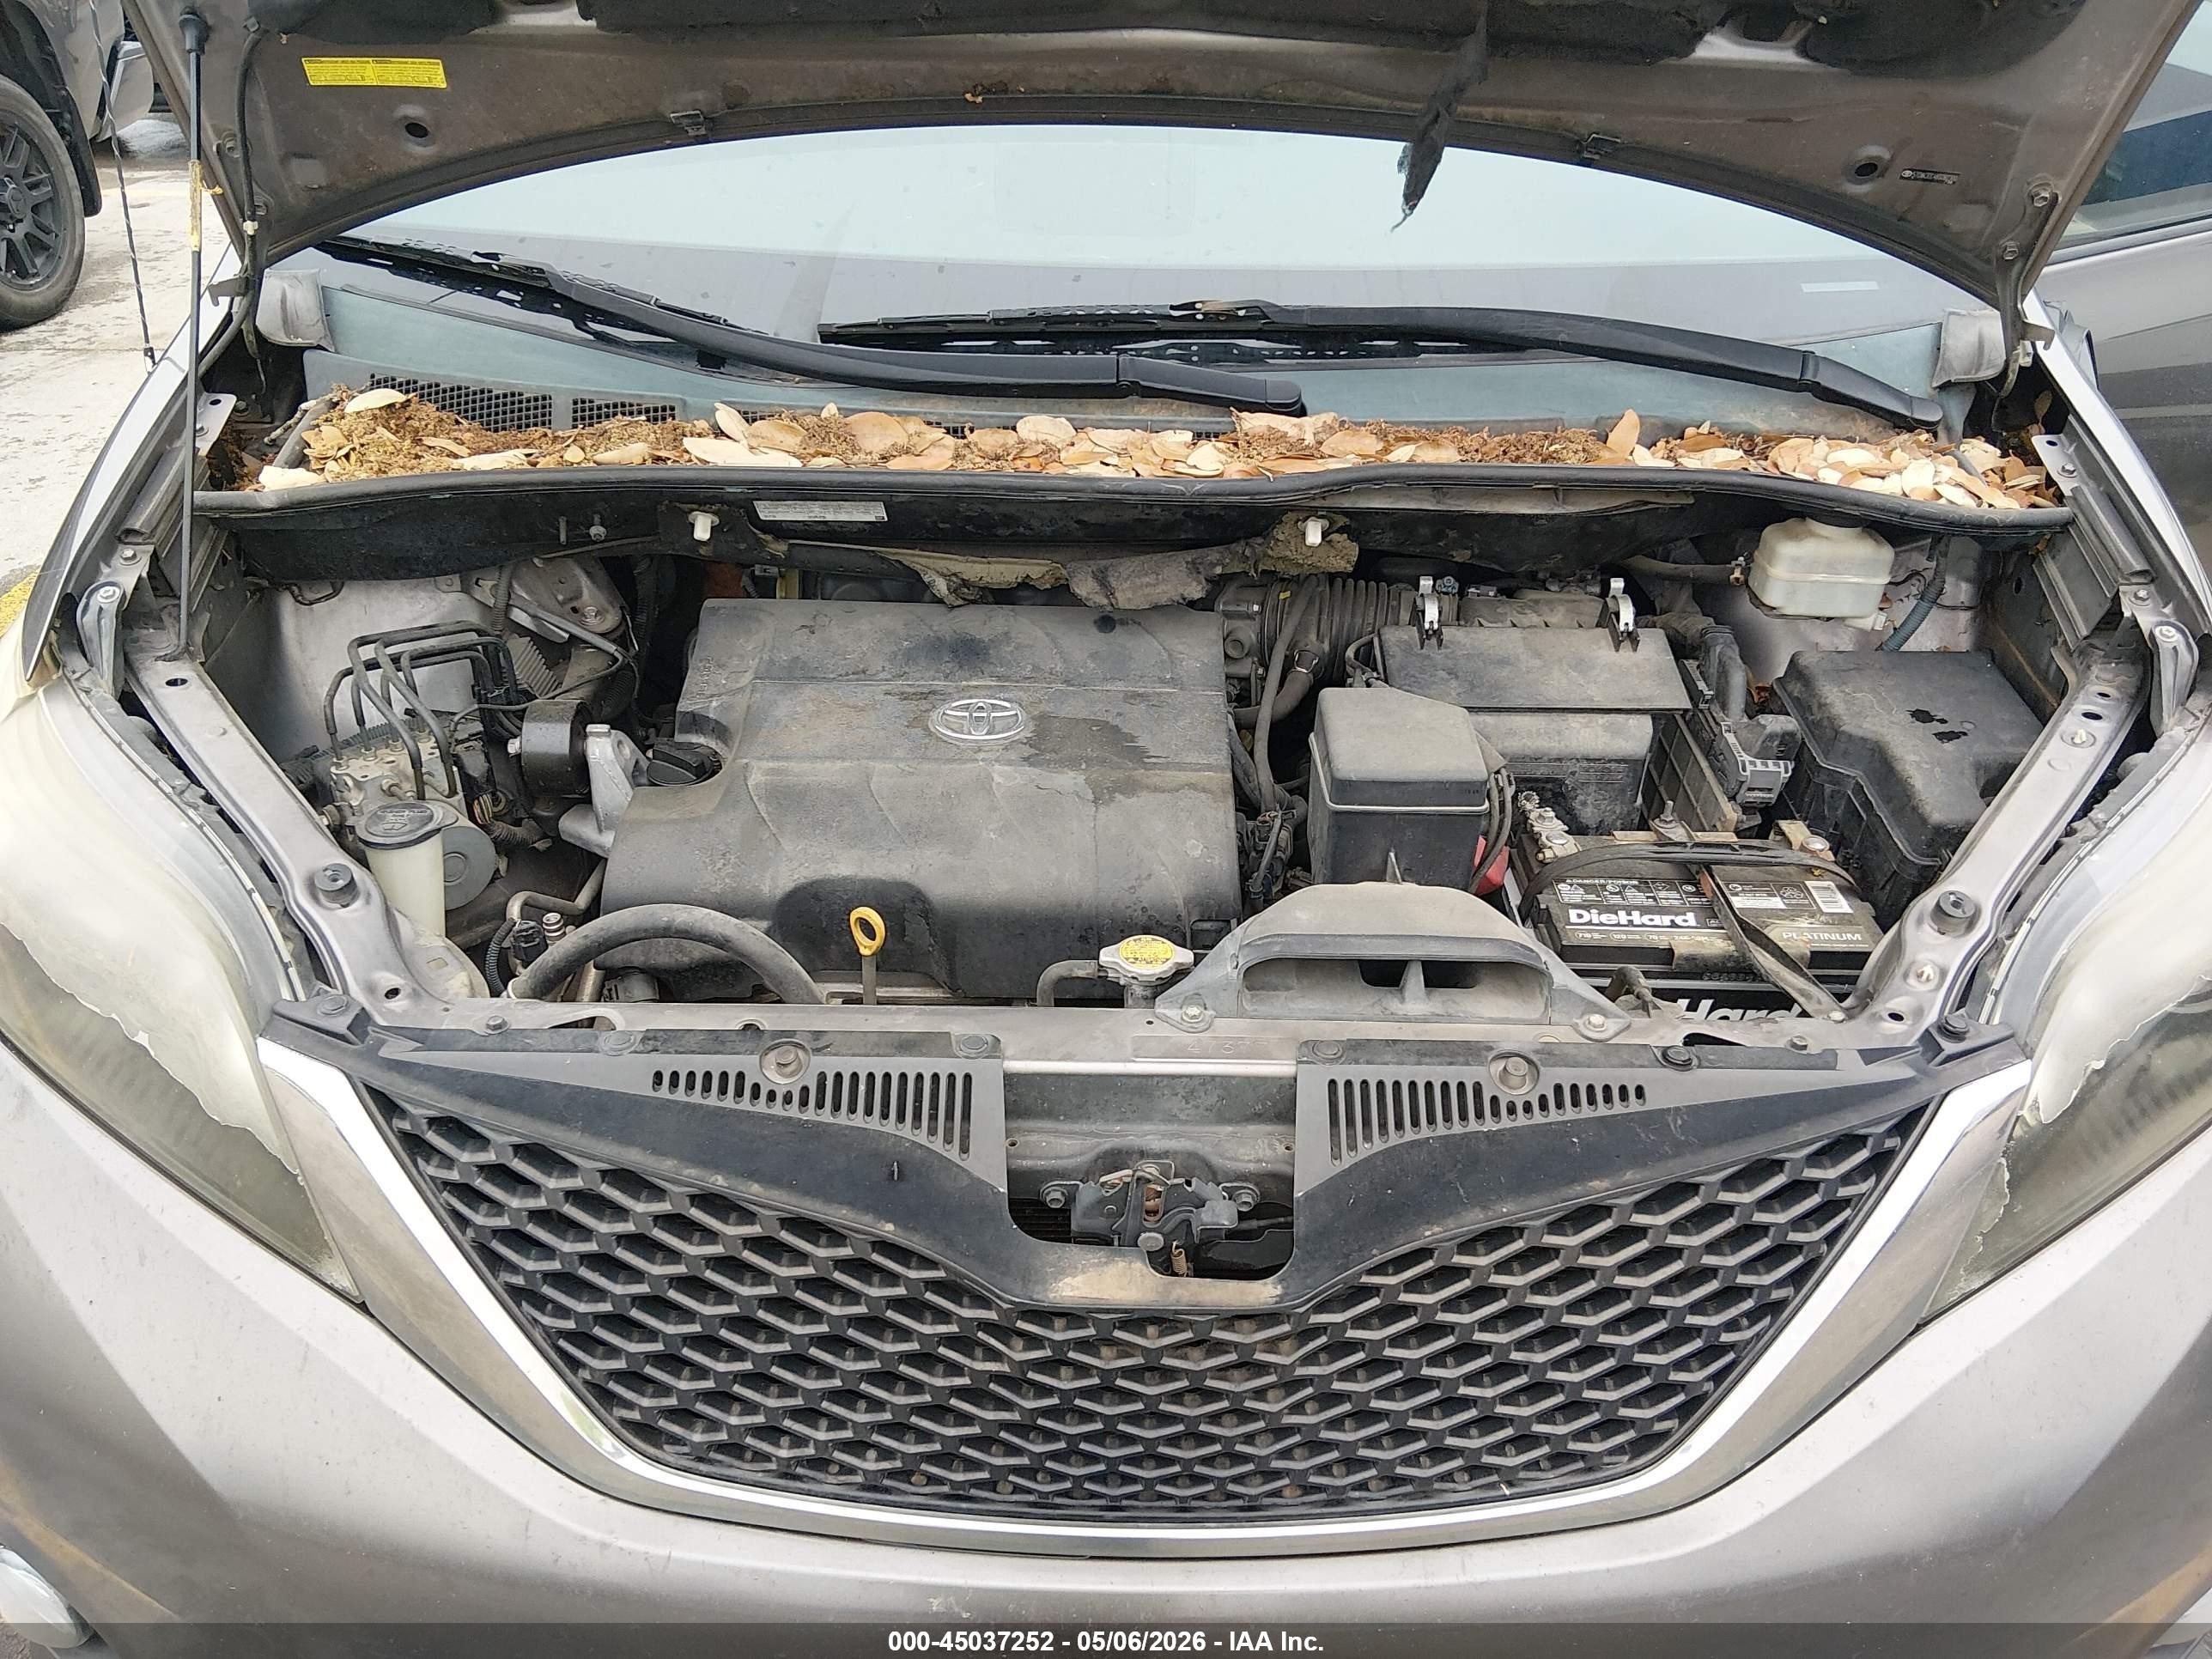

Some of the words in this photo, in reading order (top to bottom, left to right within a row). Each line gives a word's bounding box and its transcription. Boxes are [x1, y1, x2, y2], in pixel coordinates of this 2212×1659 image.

[1568, 908, 1697, 927] DieHard
[1783, 932, 1863, 941] PLATINUM
[1677, 998, 1802, 1021] Hard
